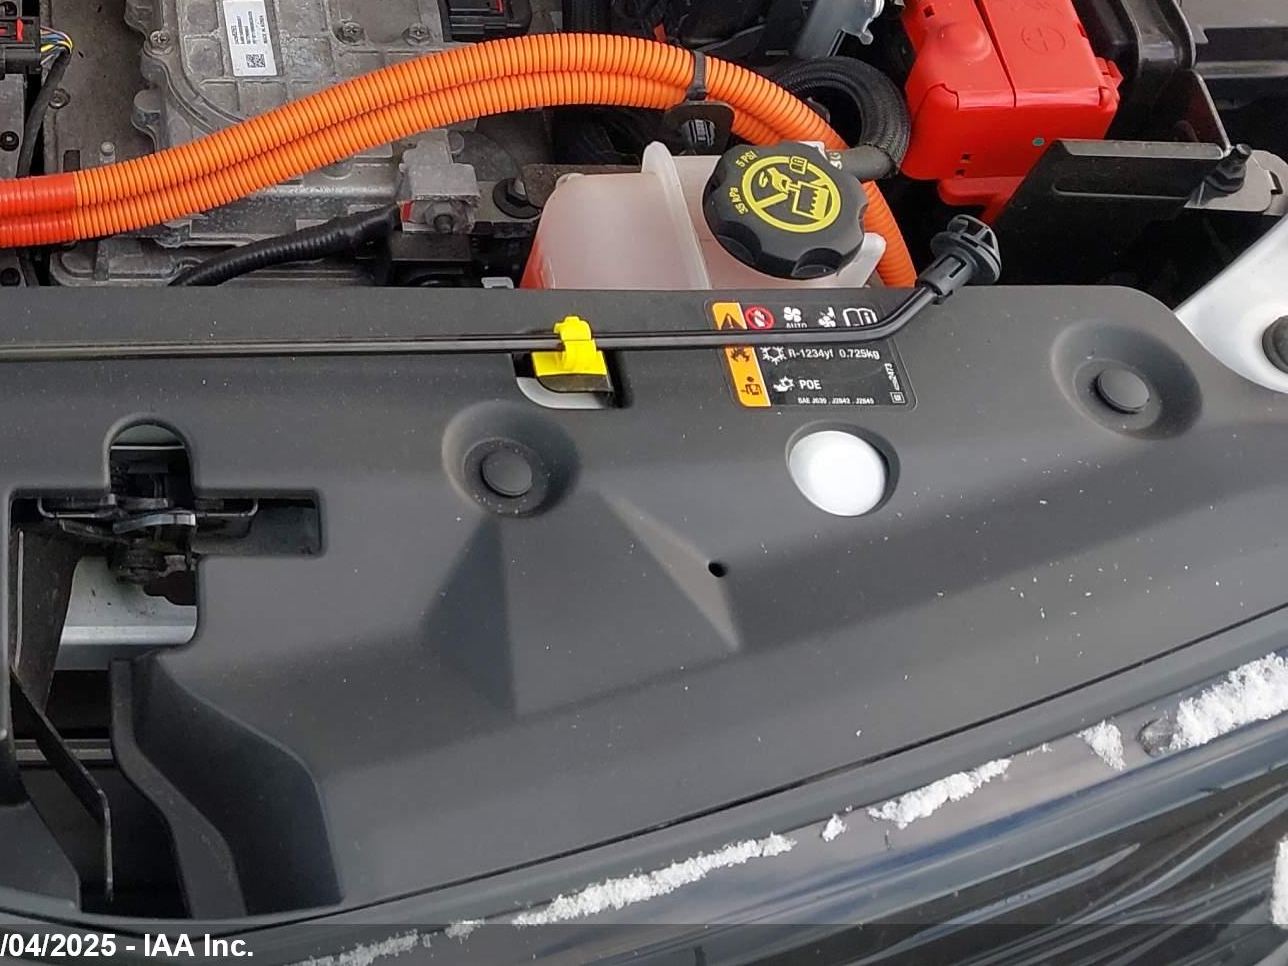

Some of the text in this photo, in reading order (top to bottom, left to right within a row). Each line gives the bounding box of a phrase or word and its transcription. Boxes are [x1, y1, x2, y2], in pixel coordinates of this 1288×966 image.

[735, 149, 759, 168] 5 PSI
[734, 202, 749, 215] 35
[788, 348, 881, 360] R-1234yf 0.725kg
[798, 379, 823, 390] POE
